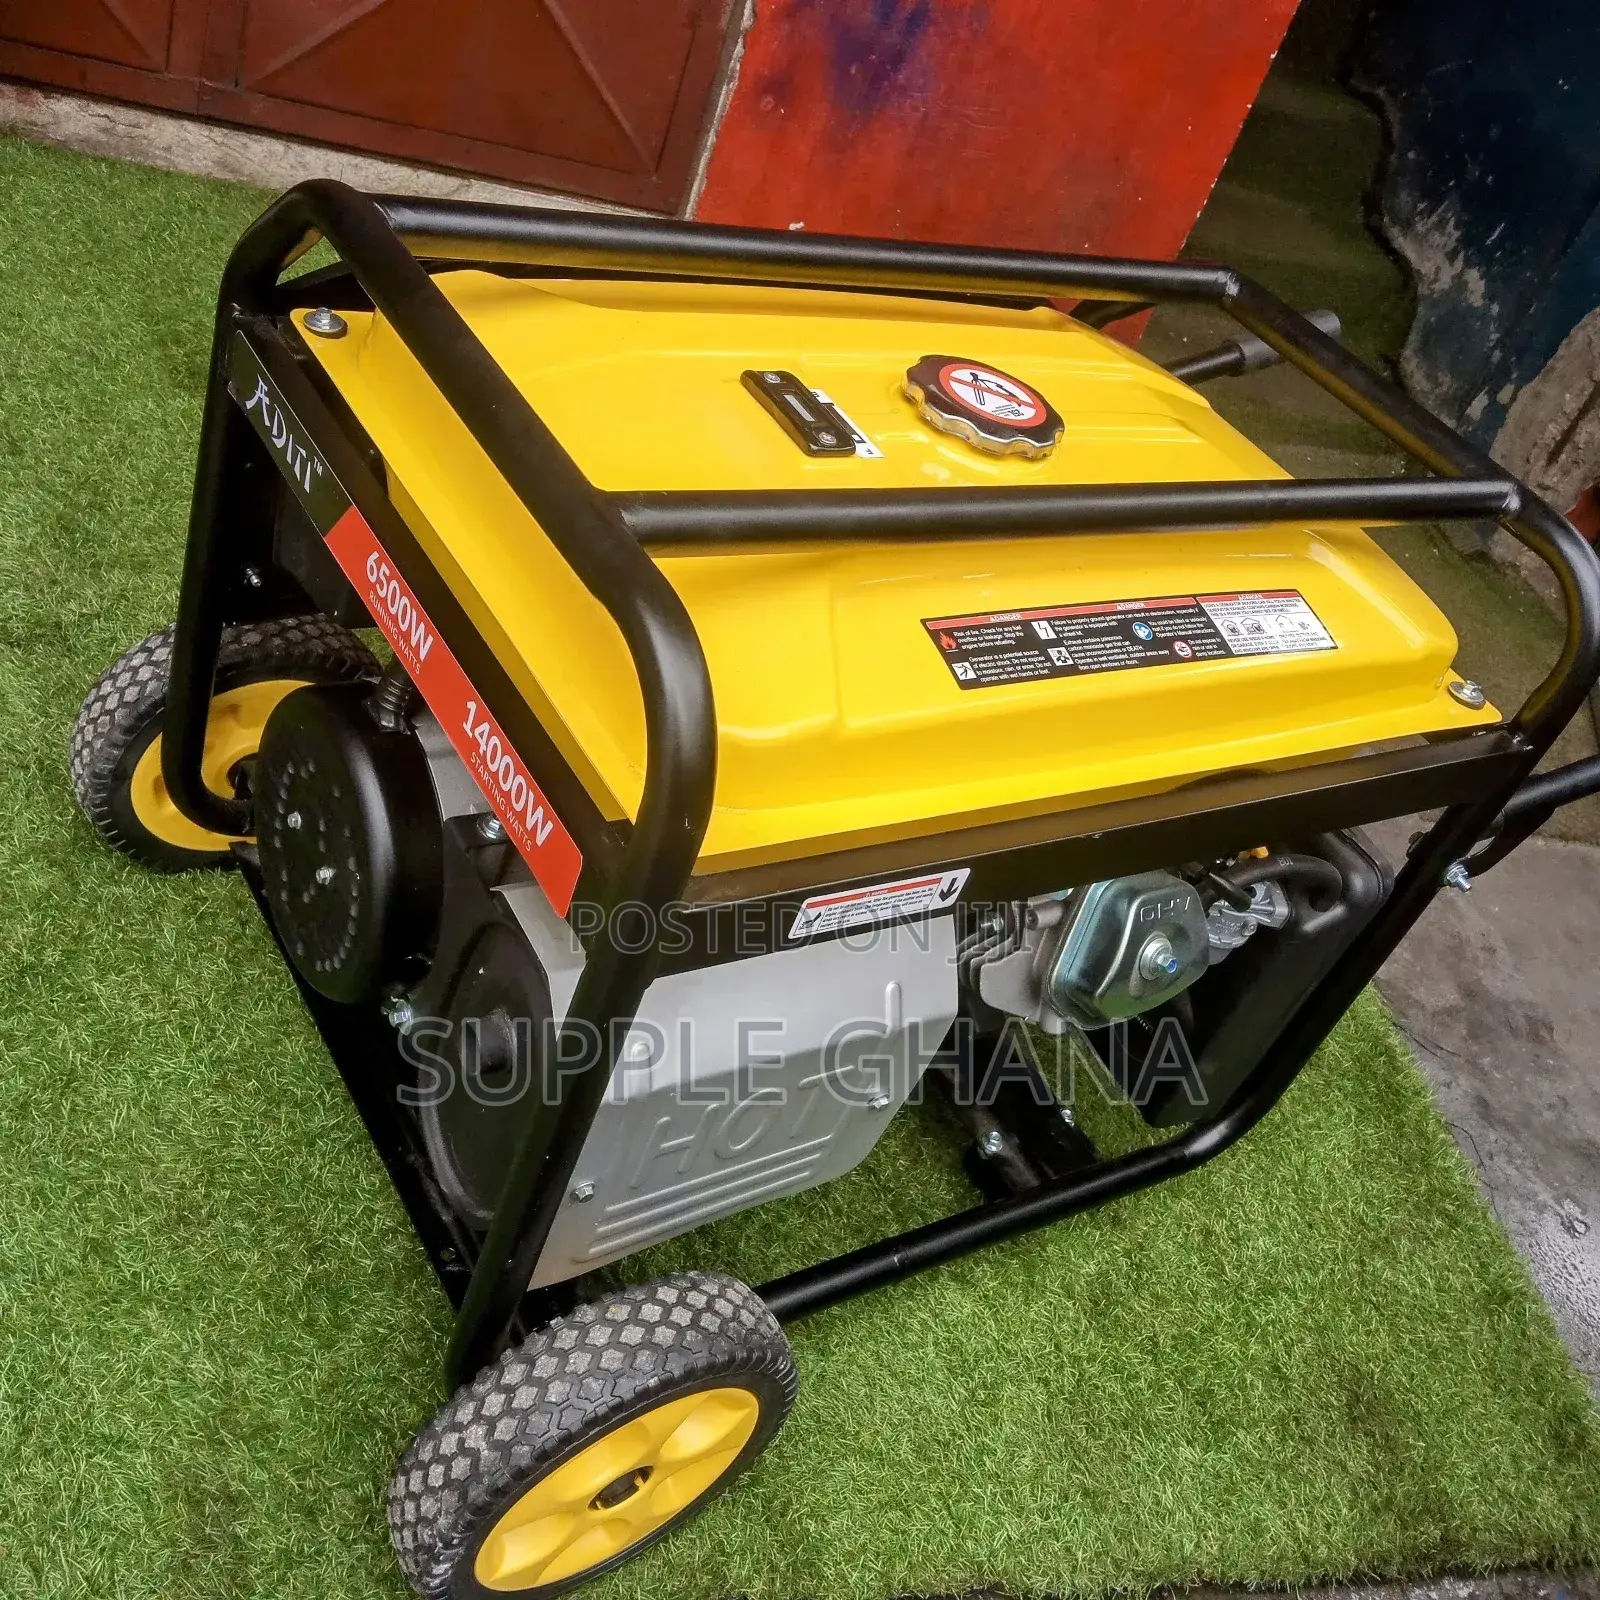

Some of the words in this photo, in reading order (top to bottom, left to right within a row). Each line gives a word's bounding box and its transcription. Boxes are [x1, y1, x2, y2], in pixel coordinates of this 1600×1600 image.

[245, 373, 311, 494] ADITI
[366, 551, 434, 662] 6500W
[369, 589, 398, 640] RUNNING
[399, 634, 421, 675] WATTS
[463, 701, 553, 847] 14000W
[470, 751, 505, 810] STARTING
[506, 808, 532, 852] WATTS
[628, 1065, 856, 1190] HOT
